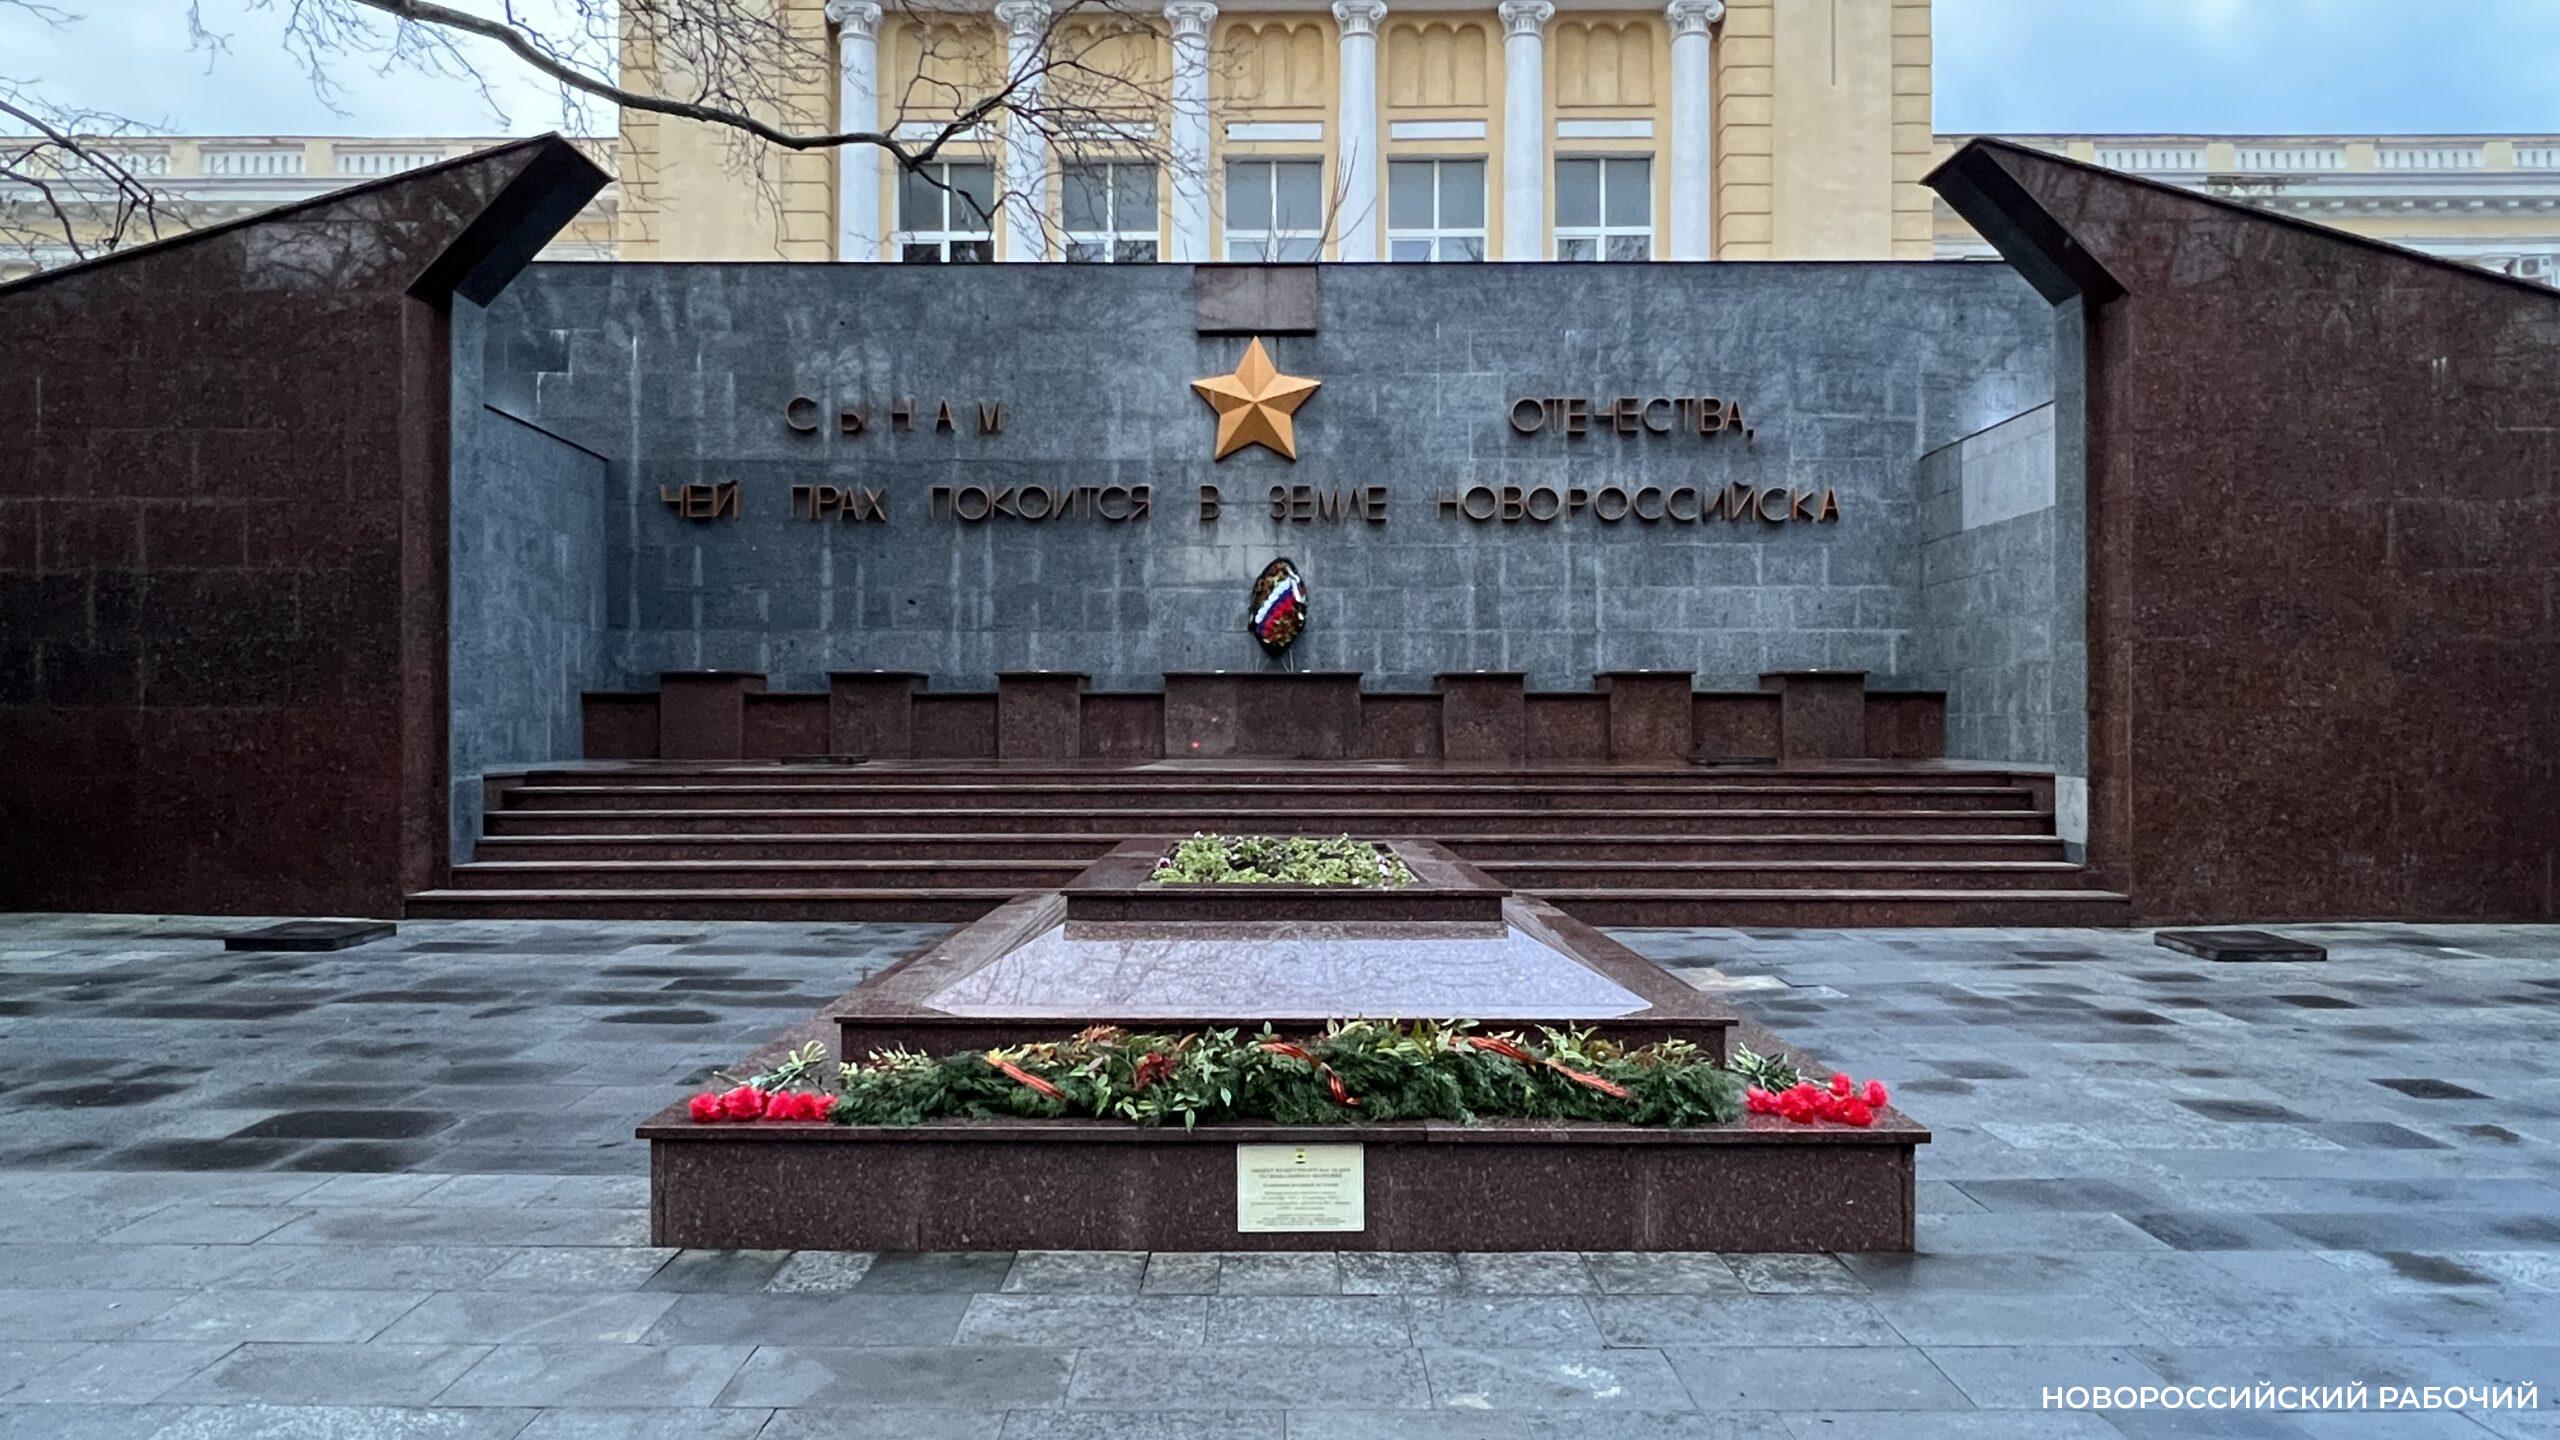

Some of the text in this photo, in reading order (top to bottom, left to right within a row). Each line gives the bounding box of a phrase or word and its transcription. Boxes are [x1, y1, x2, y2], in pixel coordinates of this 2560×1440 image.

[785, 395, 1754, 440] СЫНАМ ОТЕЧЕСТВА,
[660, 479, 1840, 524] ЧЕЙ ПРАХ ПОКОИТСЯ В ЗЕМЛЕ НОВОРОССИЙСКА
